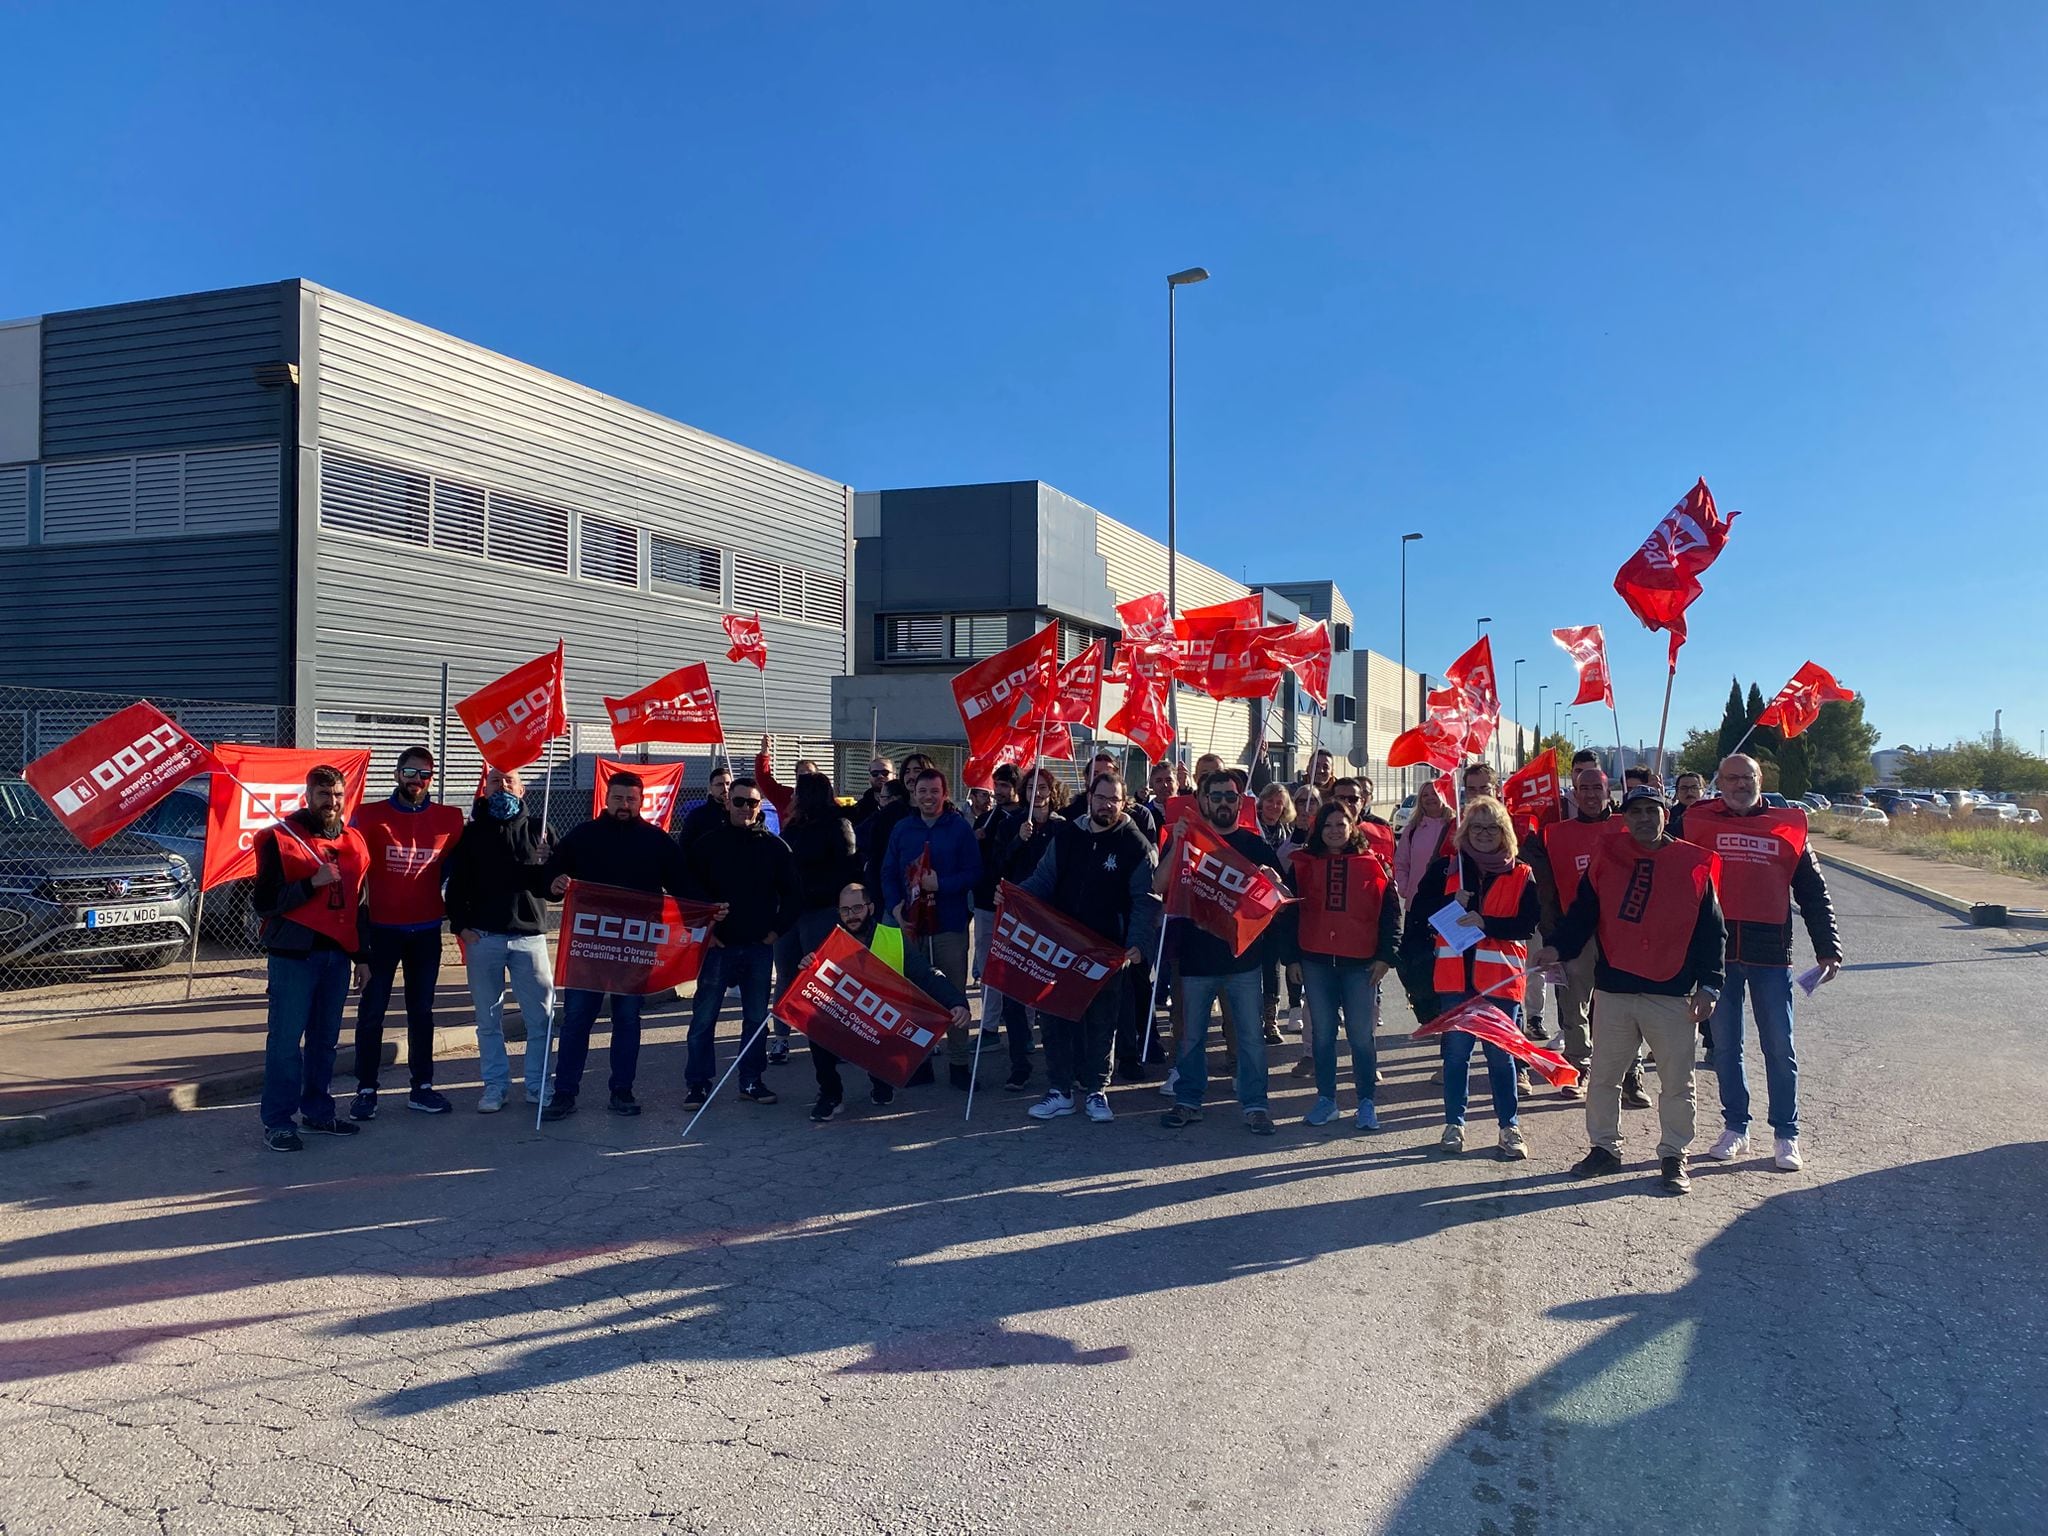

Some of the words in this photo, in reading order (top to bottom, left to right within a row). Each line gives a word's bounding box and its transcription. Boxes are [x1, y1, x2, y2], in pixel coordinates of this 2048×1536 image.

[1720, 837, 1759, 849] CCOO
[97, 911, 129, 924] 9574
[133, 909, 156, 922] MDG
[573, 912, 670, 945] CCOO
[569, 948, 581, 957] de
[582, 950, 629, 963] Castilla-La
[630, 956, 665, 967] Mancha
[571, 939, 622, 953] Comisiones
[623, 946, 658, 958] Obreras
[992, 939, 1026, 962] misiones
[1026, 959, 1056, 979] Obreras
[997, 912, 1078, 969] CCOO
[990, 947, 1029, 974] Castilla-La
[1028, 968, 1058, 985] Manc
[806, 981, 849, 1016] Comisiones
[849, 1012, 879, 1037] Obreras
[814, 958, 902, 1031] CCOO
[801, 989, 811, 999] de
[811, 996, 851, 1028] Castilla-La
[850, 1024, 881, 1046] Mancha
